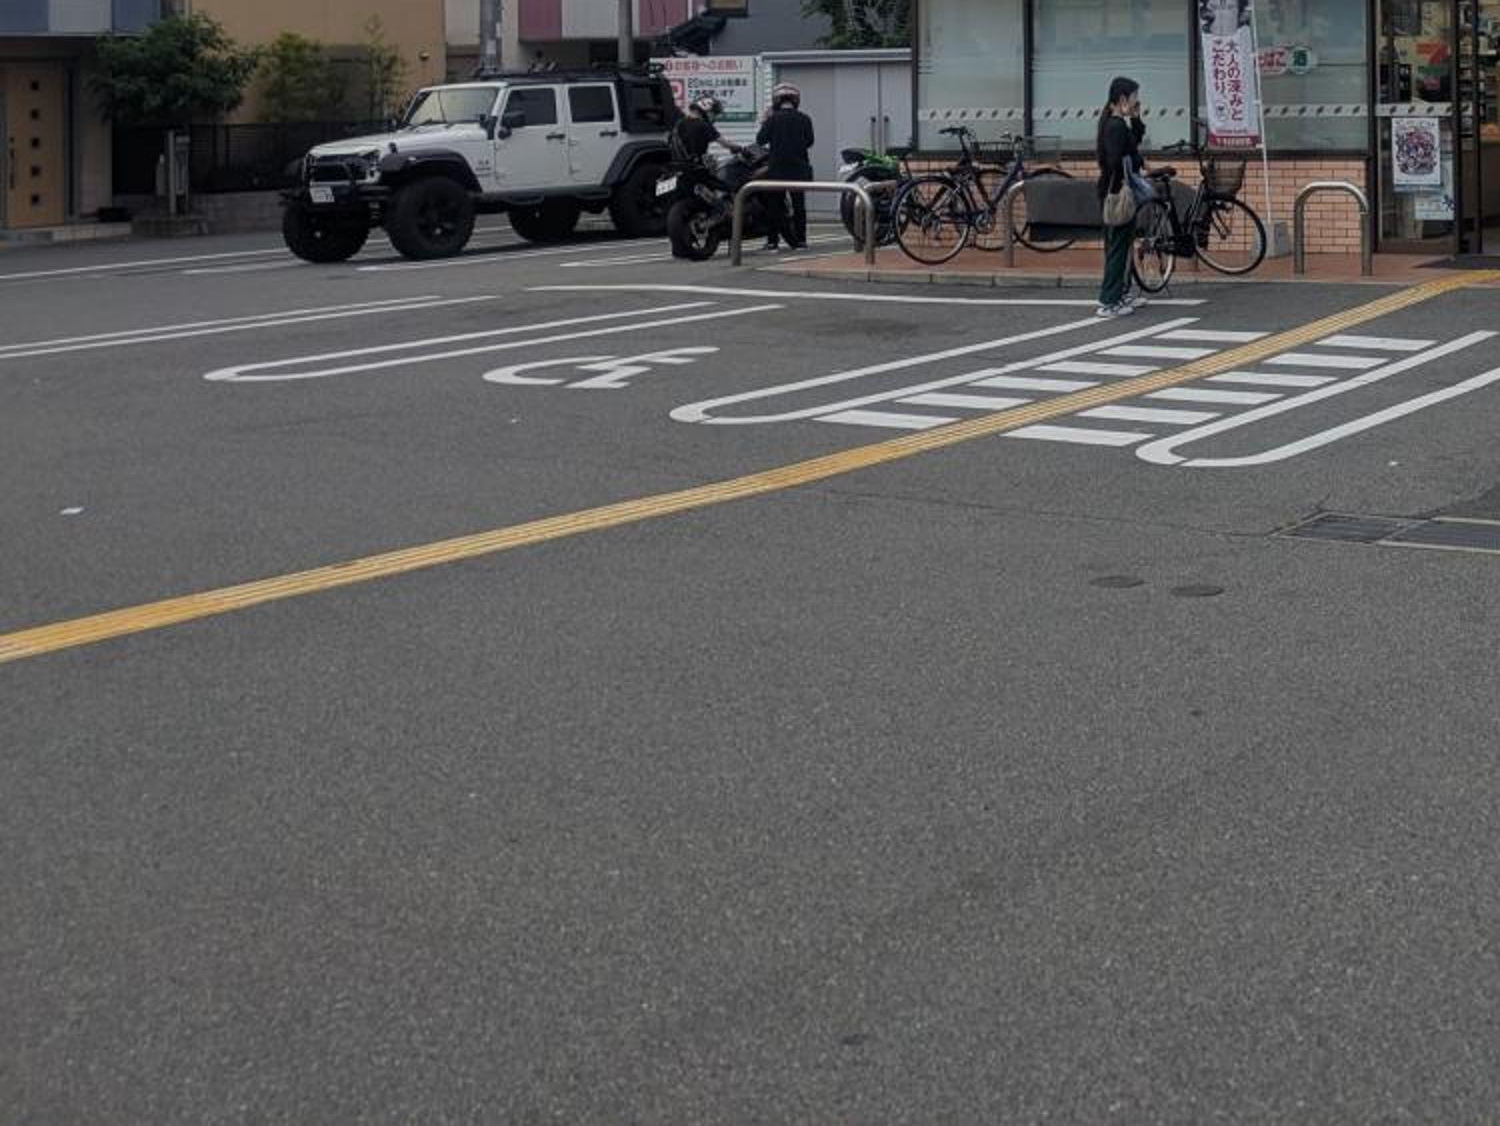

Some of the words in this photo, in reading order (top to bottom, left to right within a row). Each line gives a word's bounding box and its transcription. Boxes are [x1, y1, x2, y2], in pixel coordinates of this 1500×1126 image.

[1226, 39, 1244, 122] 大人の深みと
